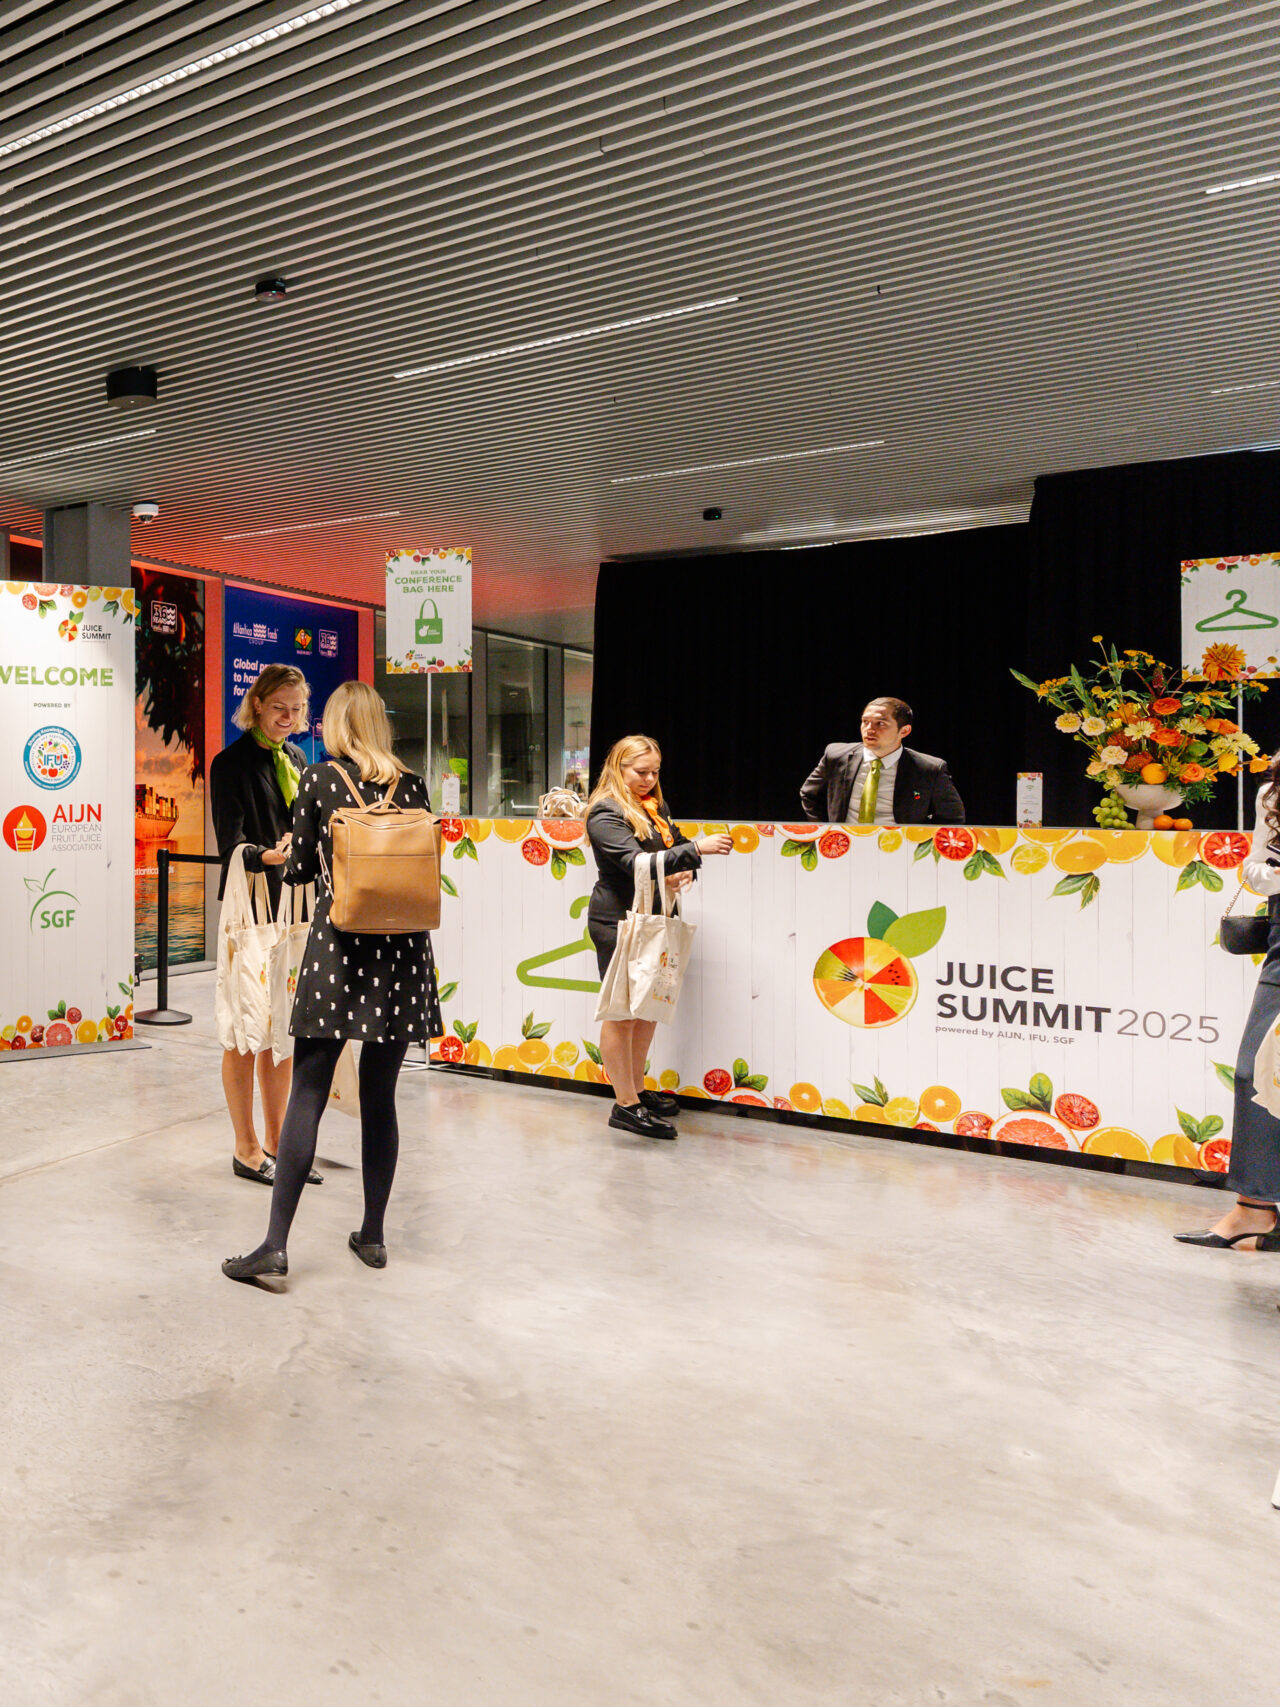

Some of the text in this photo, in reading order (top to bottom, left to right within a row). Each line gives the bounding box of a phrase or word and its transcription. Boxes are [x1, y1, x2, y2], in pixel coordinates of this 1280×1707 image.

[394, 575, 463, 585] CONFERENCE
[427, 585, 455, 593] HERE
[81, 632, 112, 640] SUMMIT
[233, 658, 259, 671] Global
[233, 672, 242, 682] to
[233, 685, 246, 696] for
[44, 754, 62, 766] IFU
[52, 804, 102, 823] AIJN
[51, 824, 102, 834] EUROPEAN
[51, 834, 102, 843] FRUIT JUICE
[52, 843, 102, 852] ASSOCIATION
[40, 909, 76, 929] SGF
[936, 961, 1055, 995] JUICE
[936, 993, 1220, 1044] SUMMIT 2025
[935, 1026, 1075, 1045] powered by AIJN, IFU, SGF
